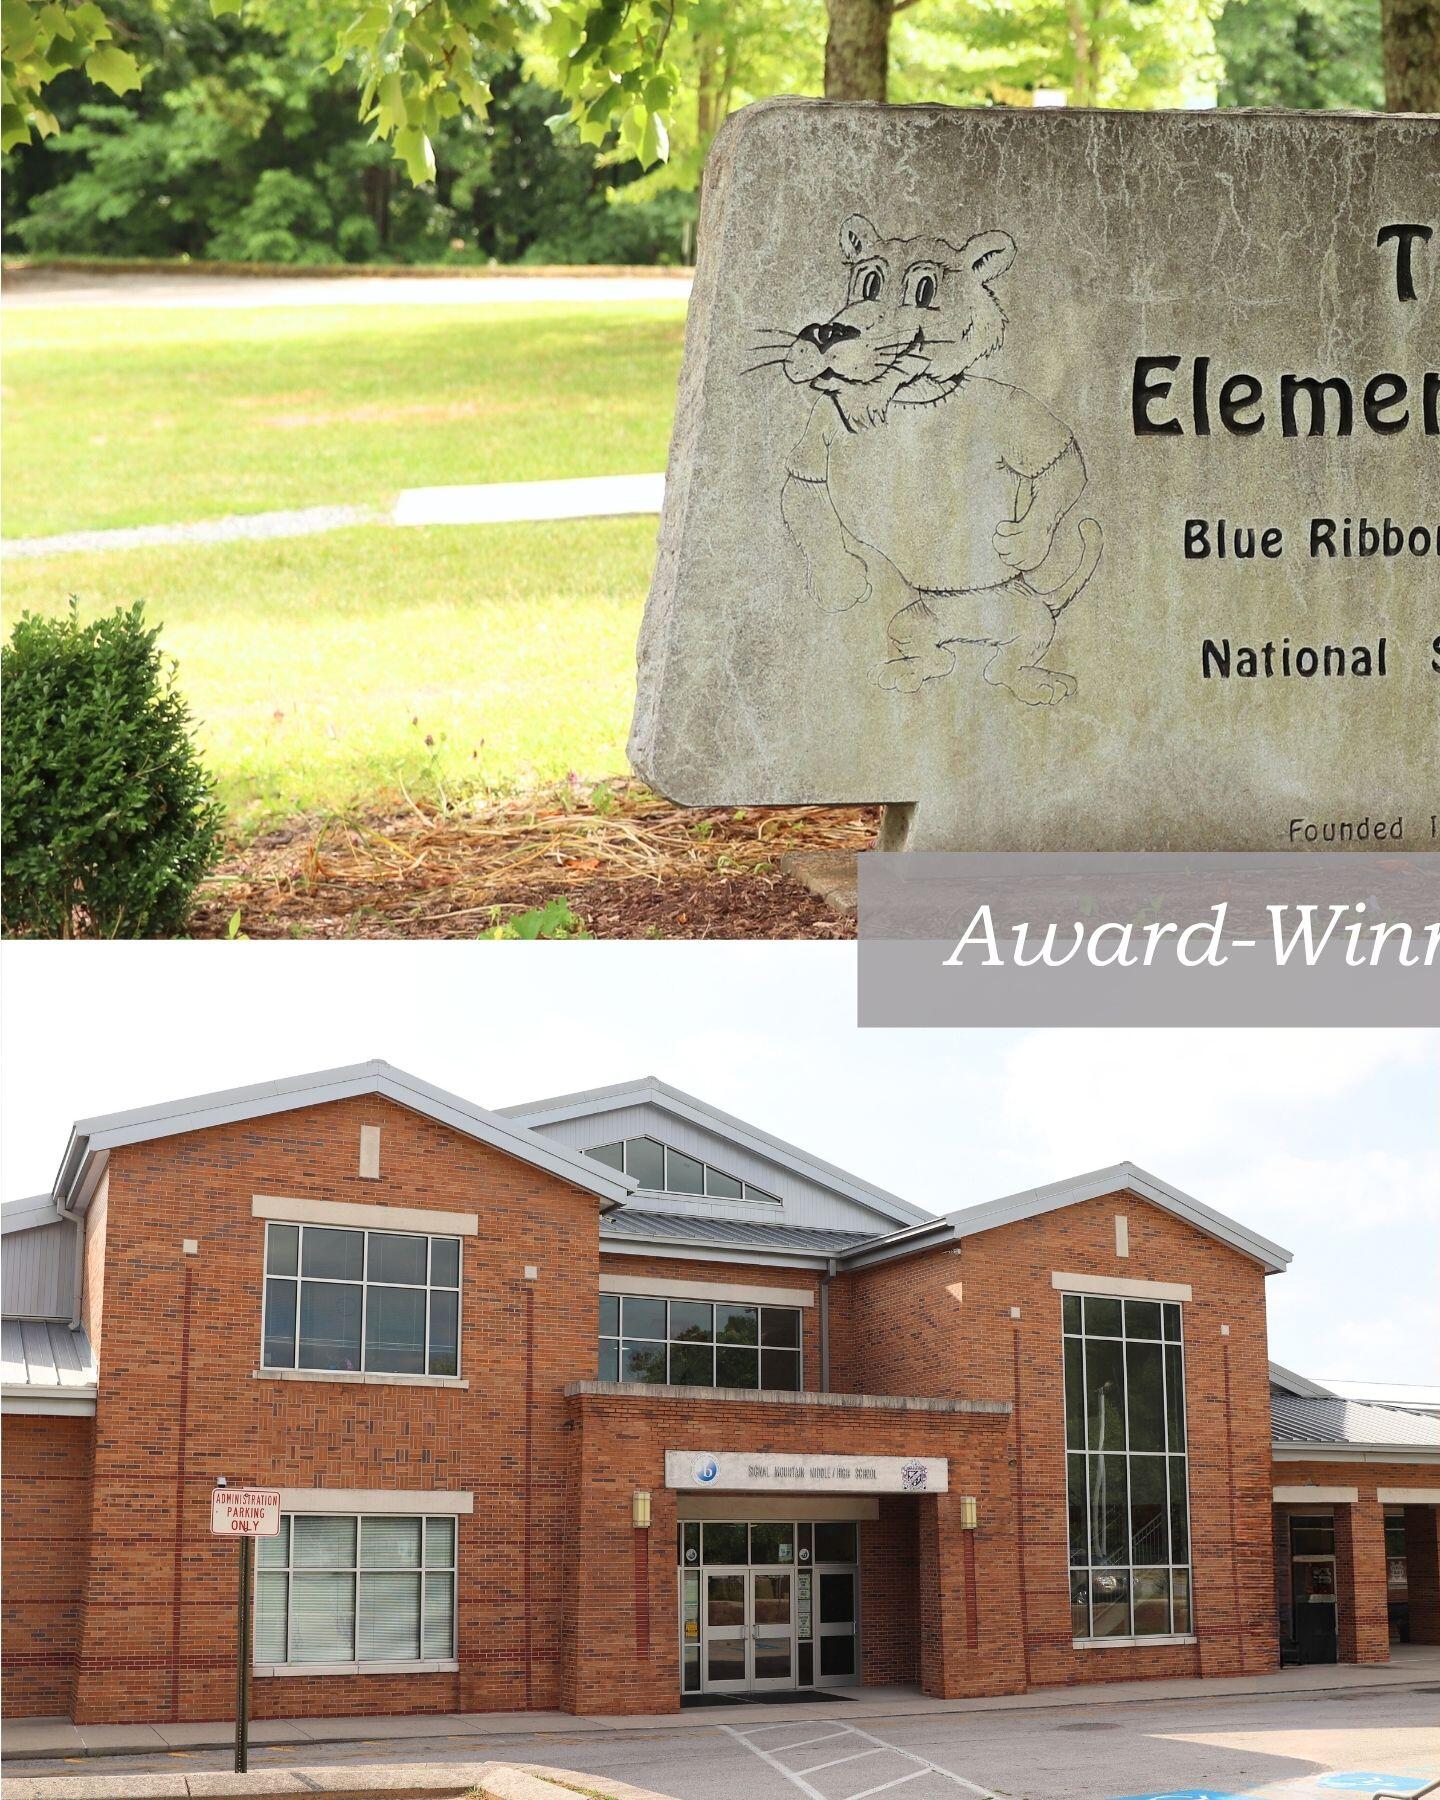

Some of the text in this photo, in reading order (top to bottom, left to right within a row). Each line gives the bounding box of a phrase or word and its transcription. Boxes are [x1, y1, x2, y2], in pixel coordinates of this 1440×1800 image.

[1184, 519, 1283, 559] Blue
[1202, 637, 1387, 679] National
[1289, 816, 1403, 842] Founded
[216, 1493, 277, 1505] ADMINISTRATION
[227, 1506, 265, 1519] PARKING
[231, 1520, 260, 1532] ONLY
